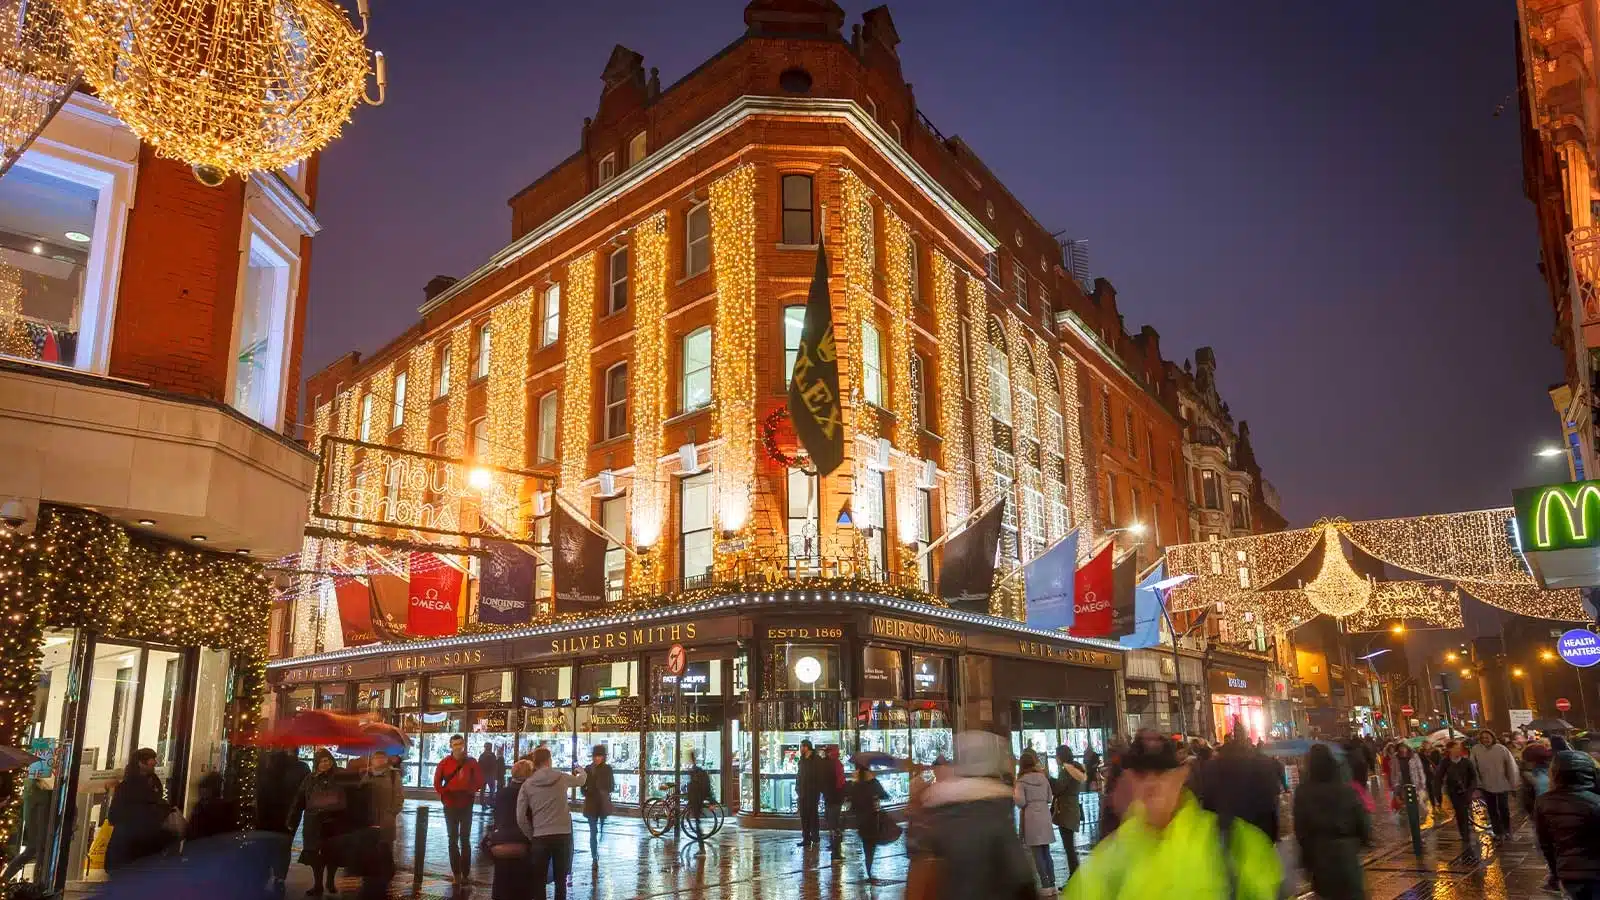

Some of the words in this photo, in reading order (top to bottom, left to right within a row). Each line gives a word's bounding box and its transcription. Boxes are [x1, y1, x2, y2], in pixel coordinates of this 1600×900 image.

[411, 596, 453, 611] OMEGA
[482, 596, 525, 609] LONGINES
[1073, 600, 1111, 614] OMEGA
[551, 622, 697, 655] SILVERSMITHS
[815, 627, 842, 638] 1869
[873, 617, 906, 638] WEIR
[914, 622, 945, 646] SONS
[1563, 637, 1596, 648] HEALTH
[1020, 639, 1052, 657] WEIR
[1067, 648, 1096, 664] SONS
[1563, 647, 1600, 657] MATTERS
[397, 655, 426, 670] WEIR
